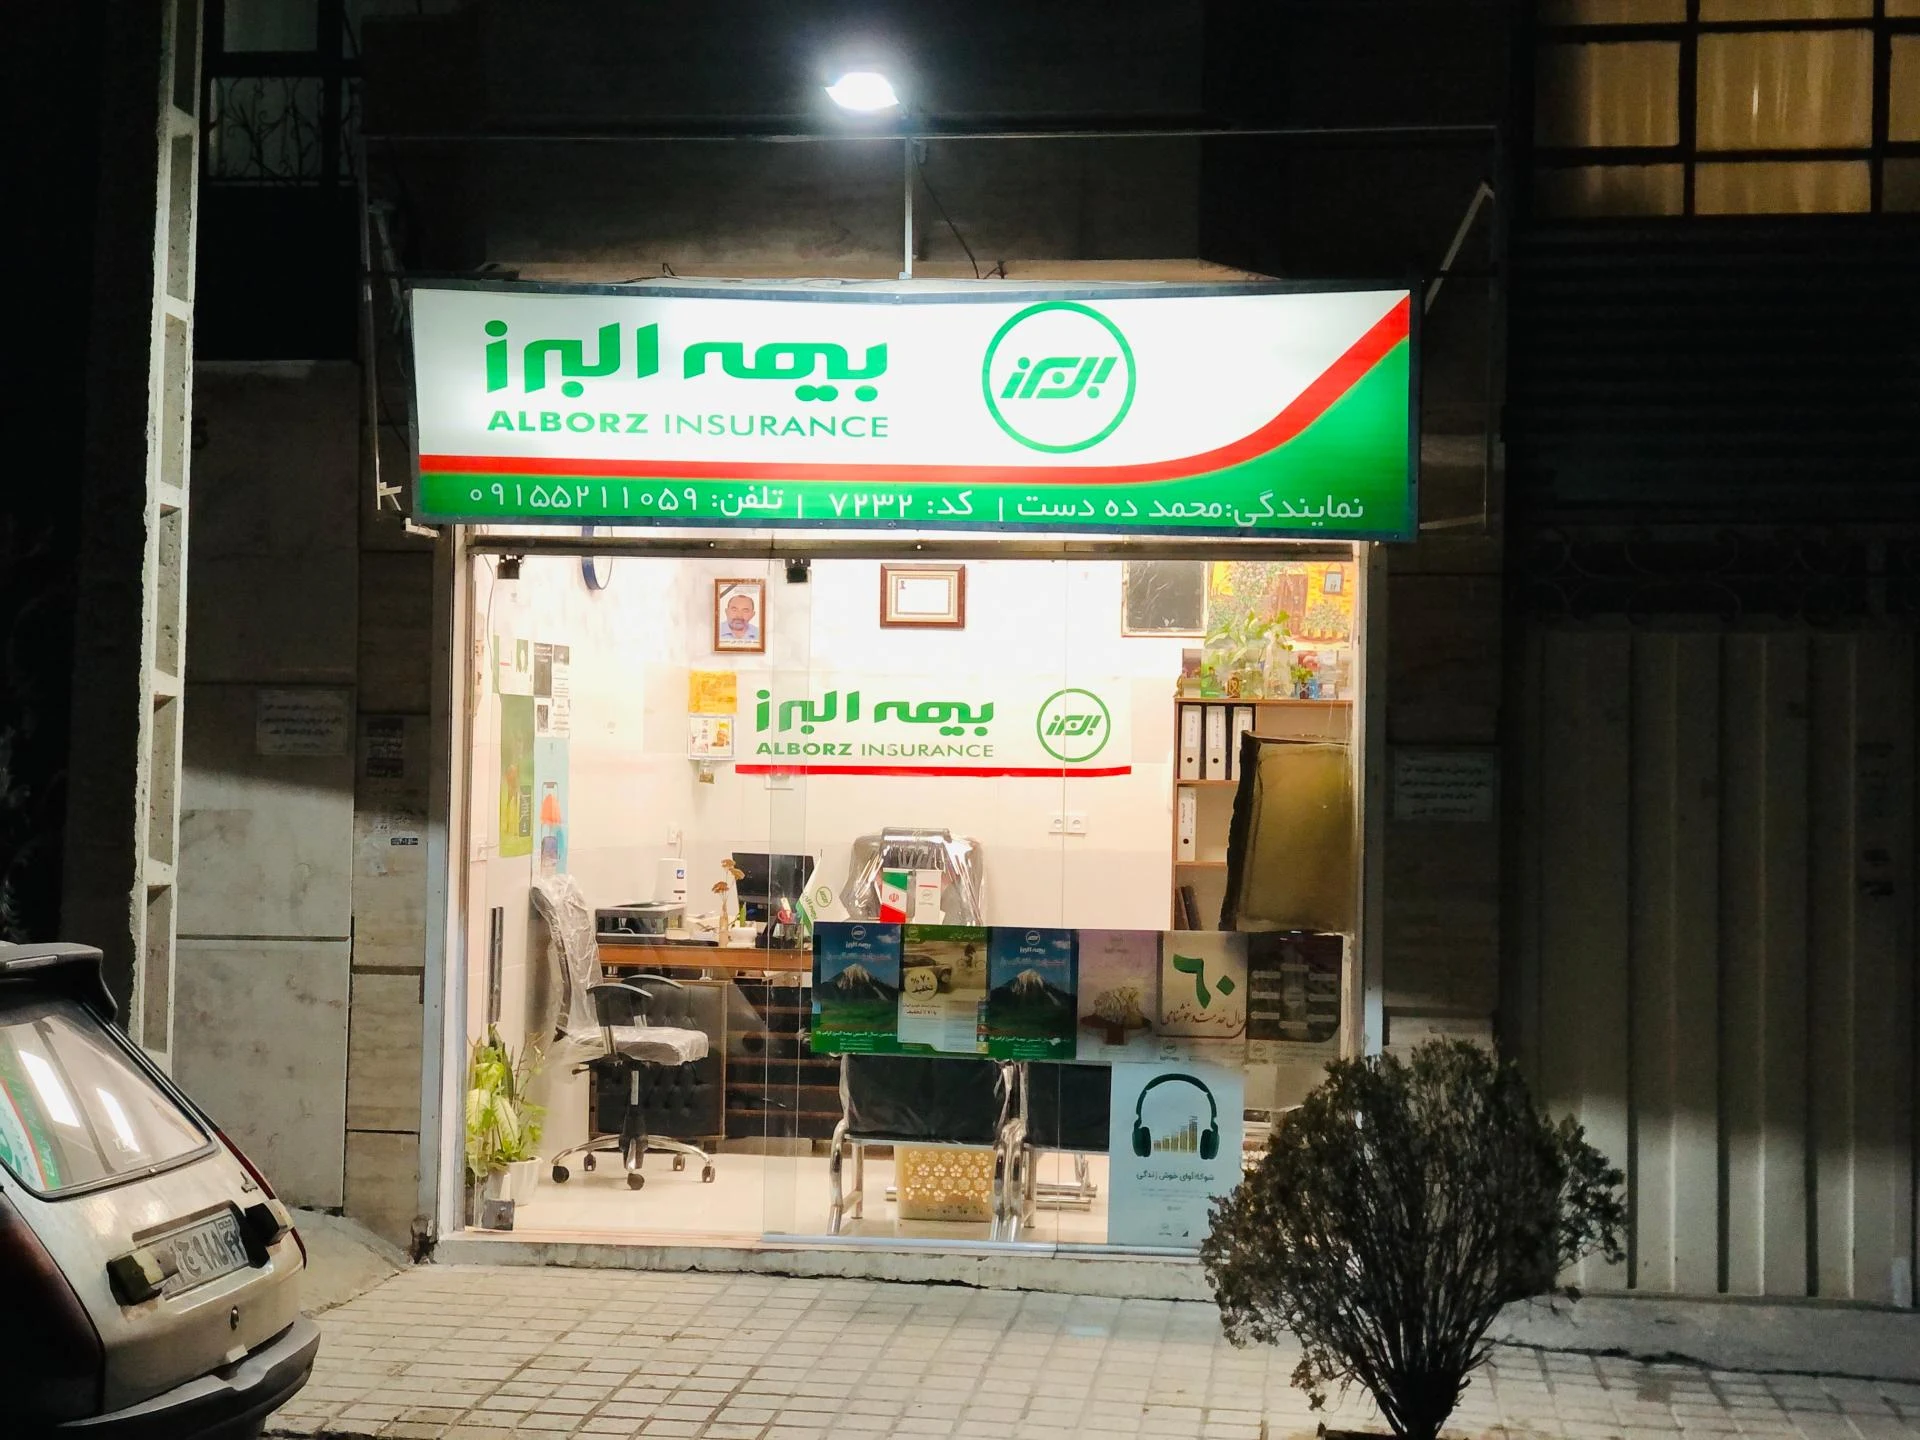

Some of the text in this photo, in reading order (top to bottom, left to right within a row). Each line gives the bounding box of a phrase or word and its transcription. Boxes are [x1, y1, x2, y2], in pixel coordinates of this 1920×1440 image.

[484, 319, 888, 402] بیمه البرز
[487, 410, 889, 438] ALBORZ INSURANCE
[470, 483, 697, 512] ۰۹۱۵۵۲۱۱۰۵۹
[711, 485, 784, 517] تلفن:
[829, 492, 912, 518] ۷۲۳۲
[927, 490, 974, 516] کد:
[1018, 495, 1095, 518] دست
[1105, 500, 1138, 518] ده
[756, 689, 860, 735] البرز
[874, 701, 994, 736] بیمه
[756, 742, 994, 758] ALBORZ INSURANCE
[1173, 954, 1236, 1009] ۶۰
[1226, 1008, 1246, 1028] سال
